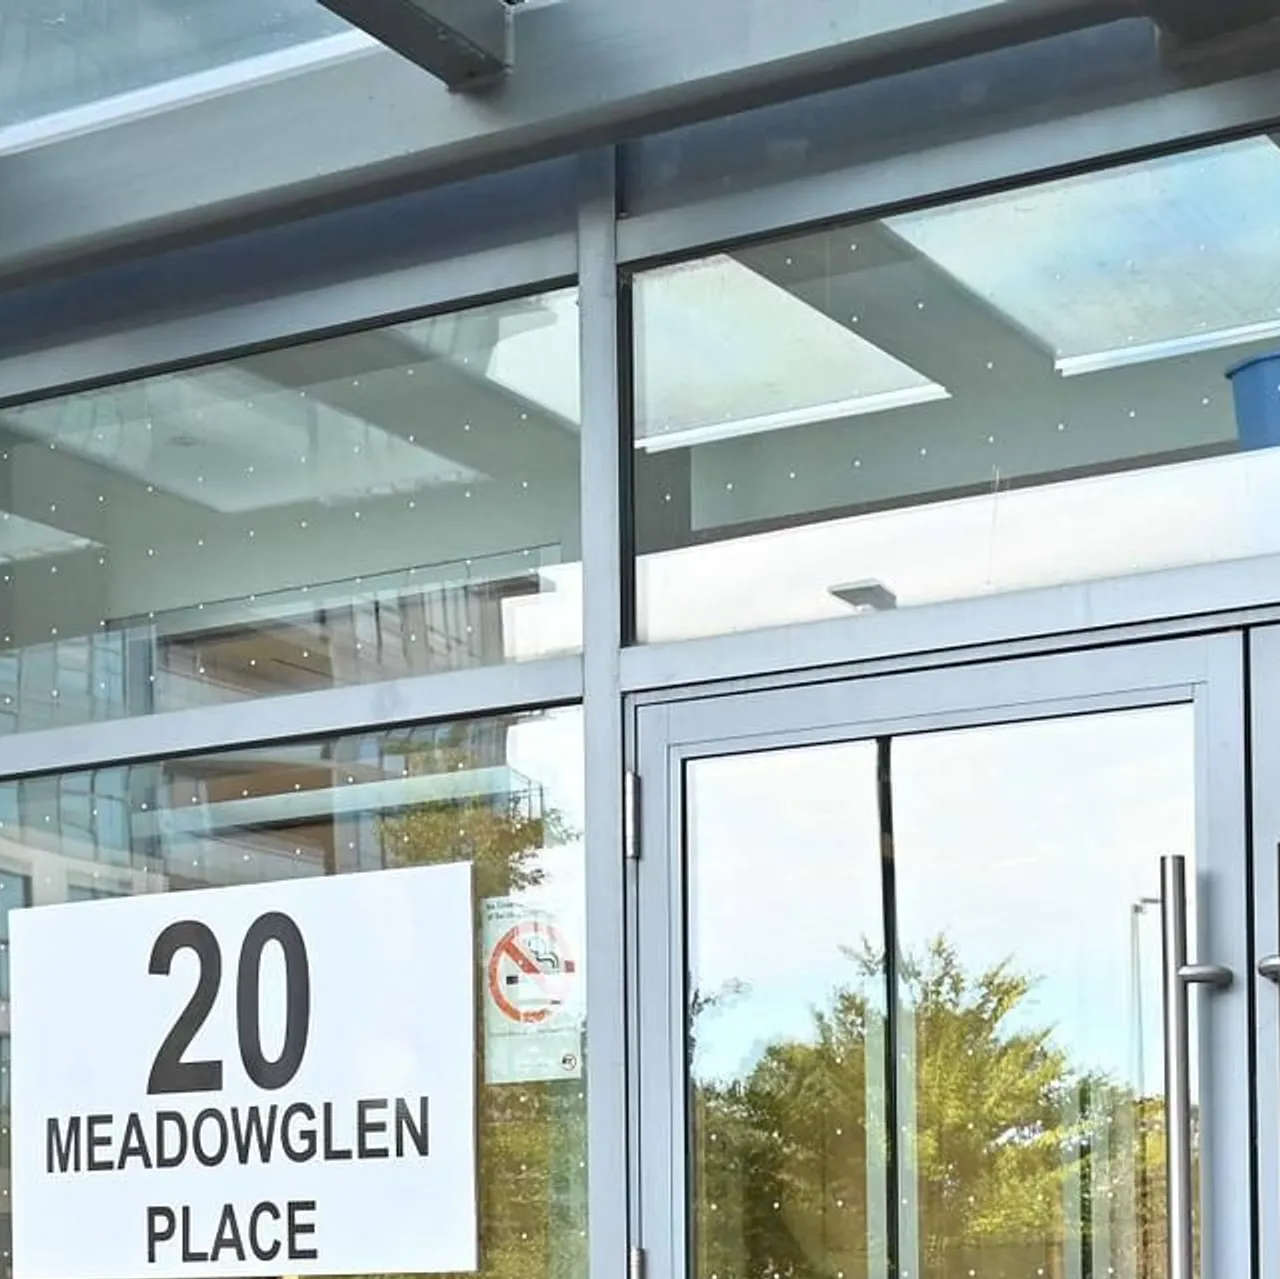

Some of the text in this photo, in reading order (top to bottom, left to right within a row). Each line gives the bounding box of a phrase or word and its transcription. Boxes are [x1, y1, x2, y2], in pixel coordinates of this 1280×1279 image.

[146, 911, 311, 1096] 20
[46, 1096, 430, 1174] MEADOWGLEN
[146, 1200, 319, 1264] PLACE
